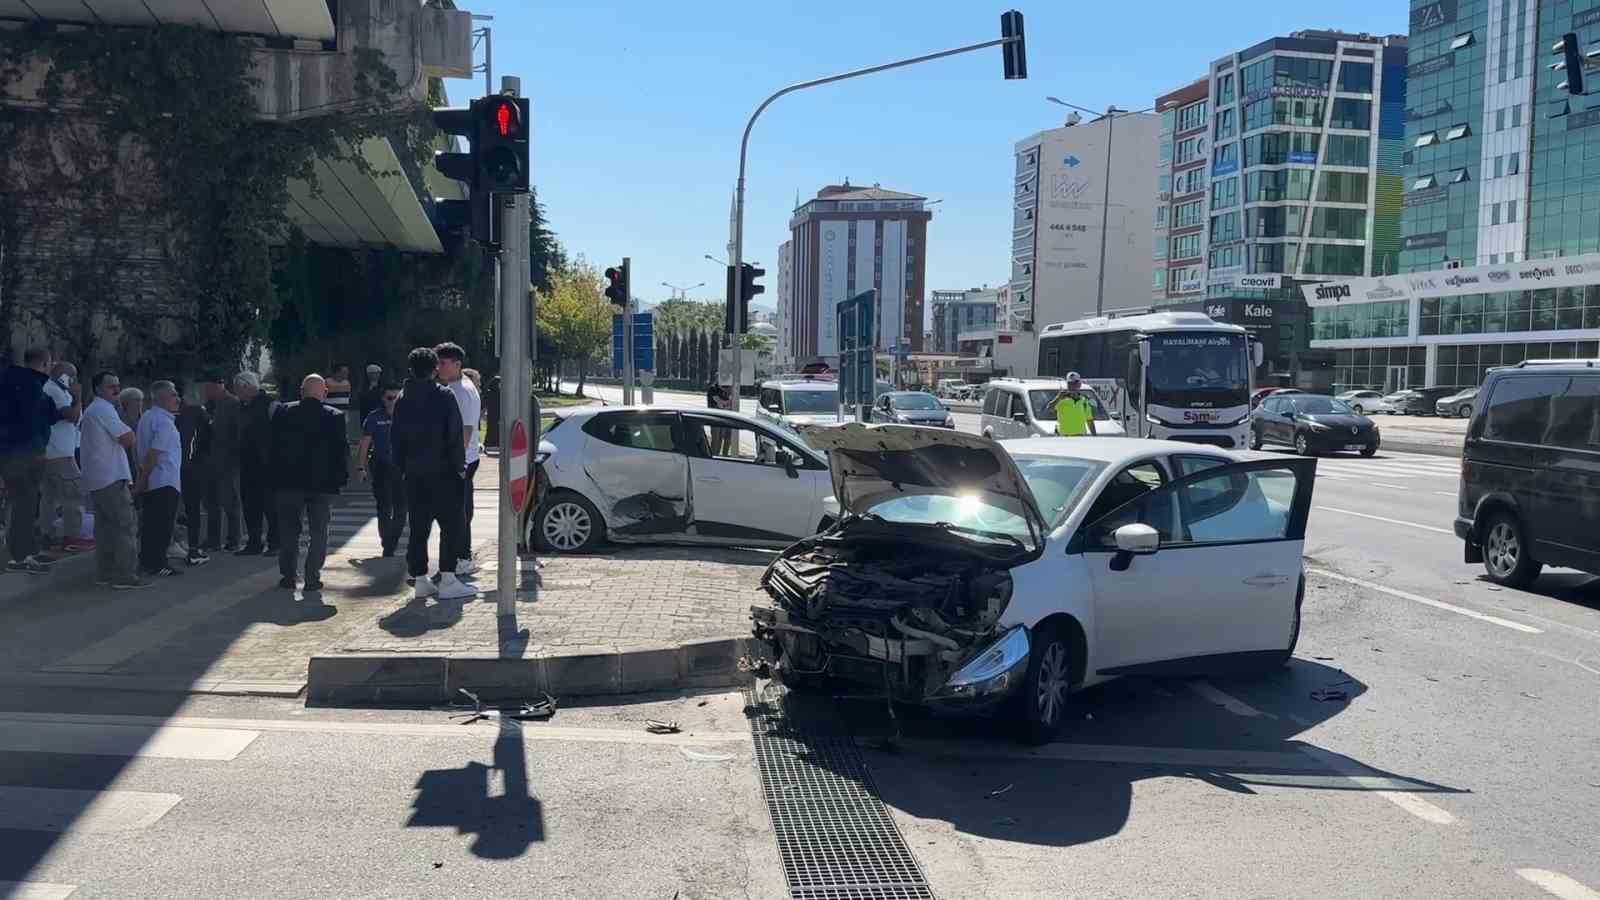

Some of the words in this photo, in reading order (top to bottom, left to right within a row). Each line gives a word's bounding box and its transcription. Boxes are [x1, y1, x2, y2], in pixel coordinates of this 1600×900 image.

[1241, 277, 1275, 287] creovit
[1315, 283, 1351, 302] simpa
[1244, 304, 1273, 317] Kale
